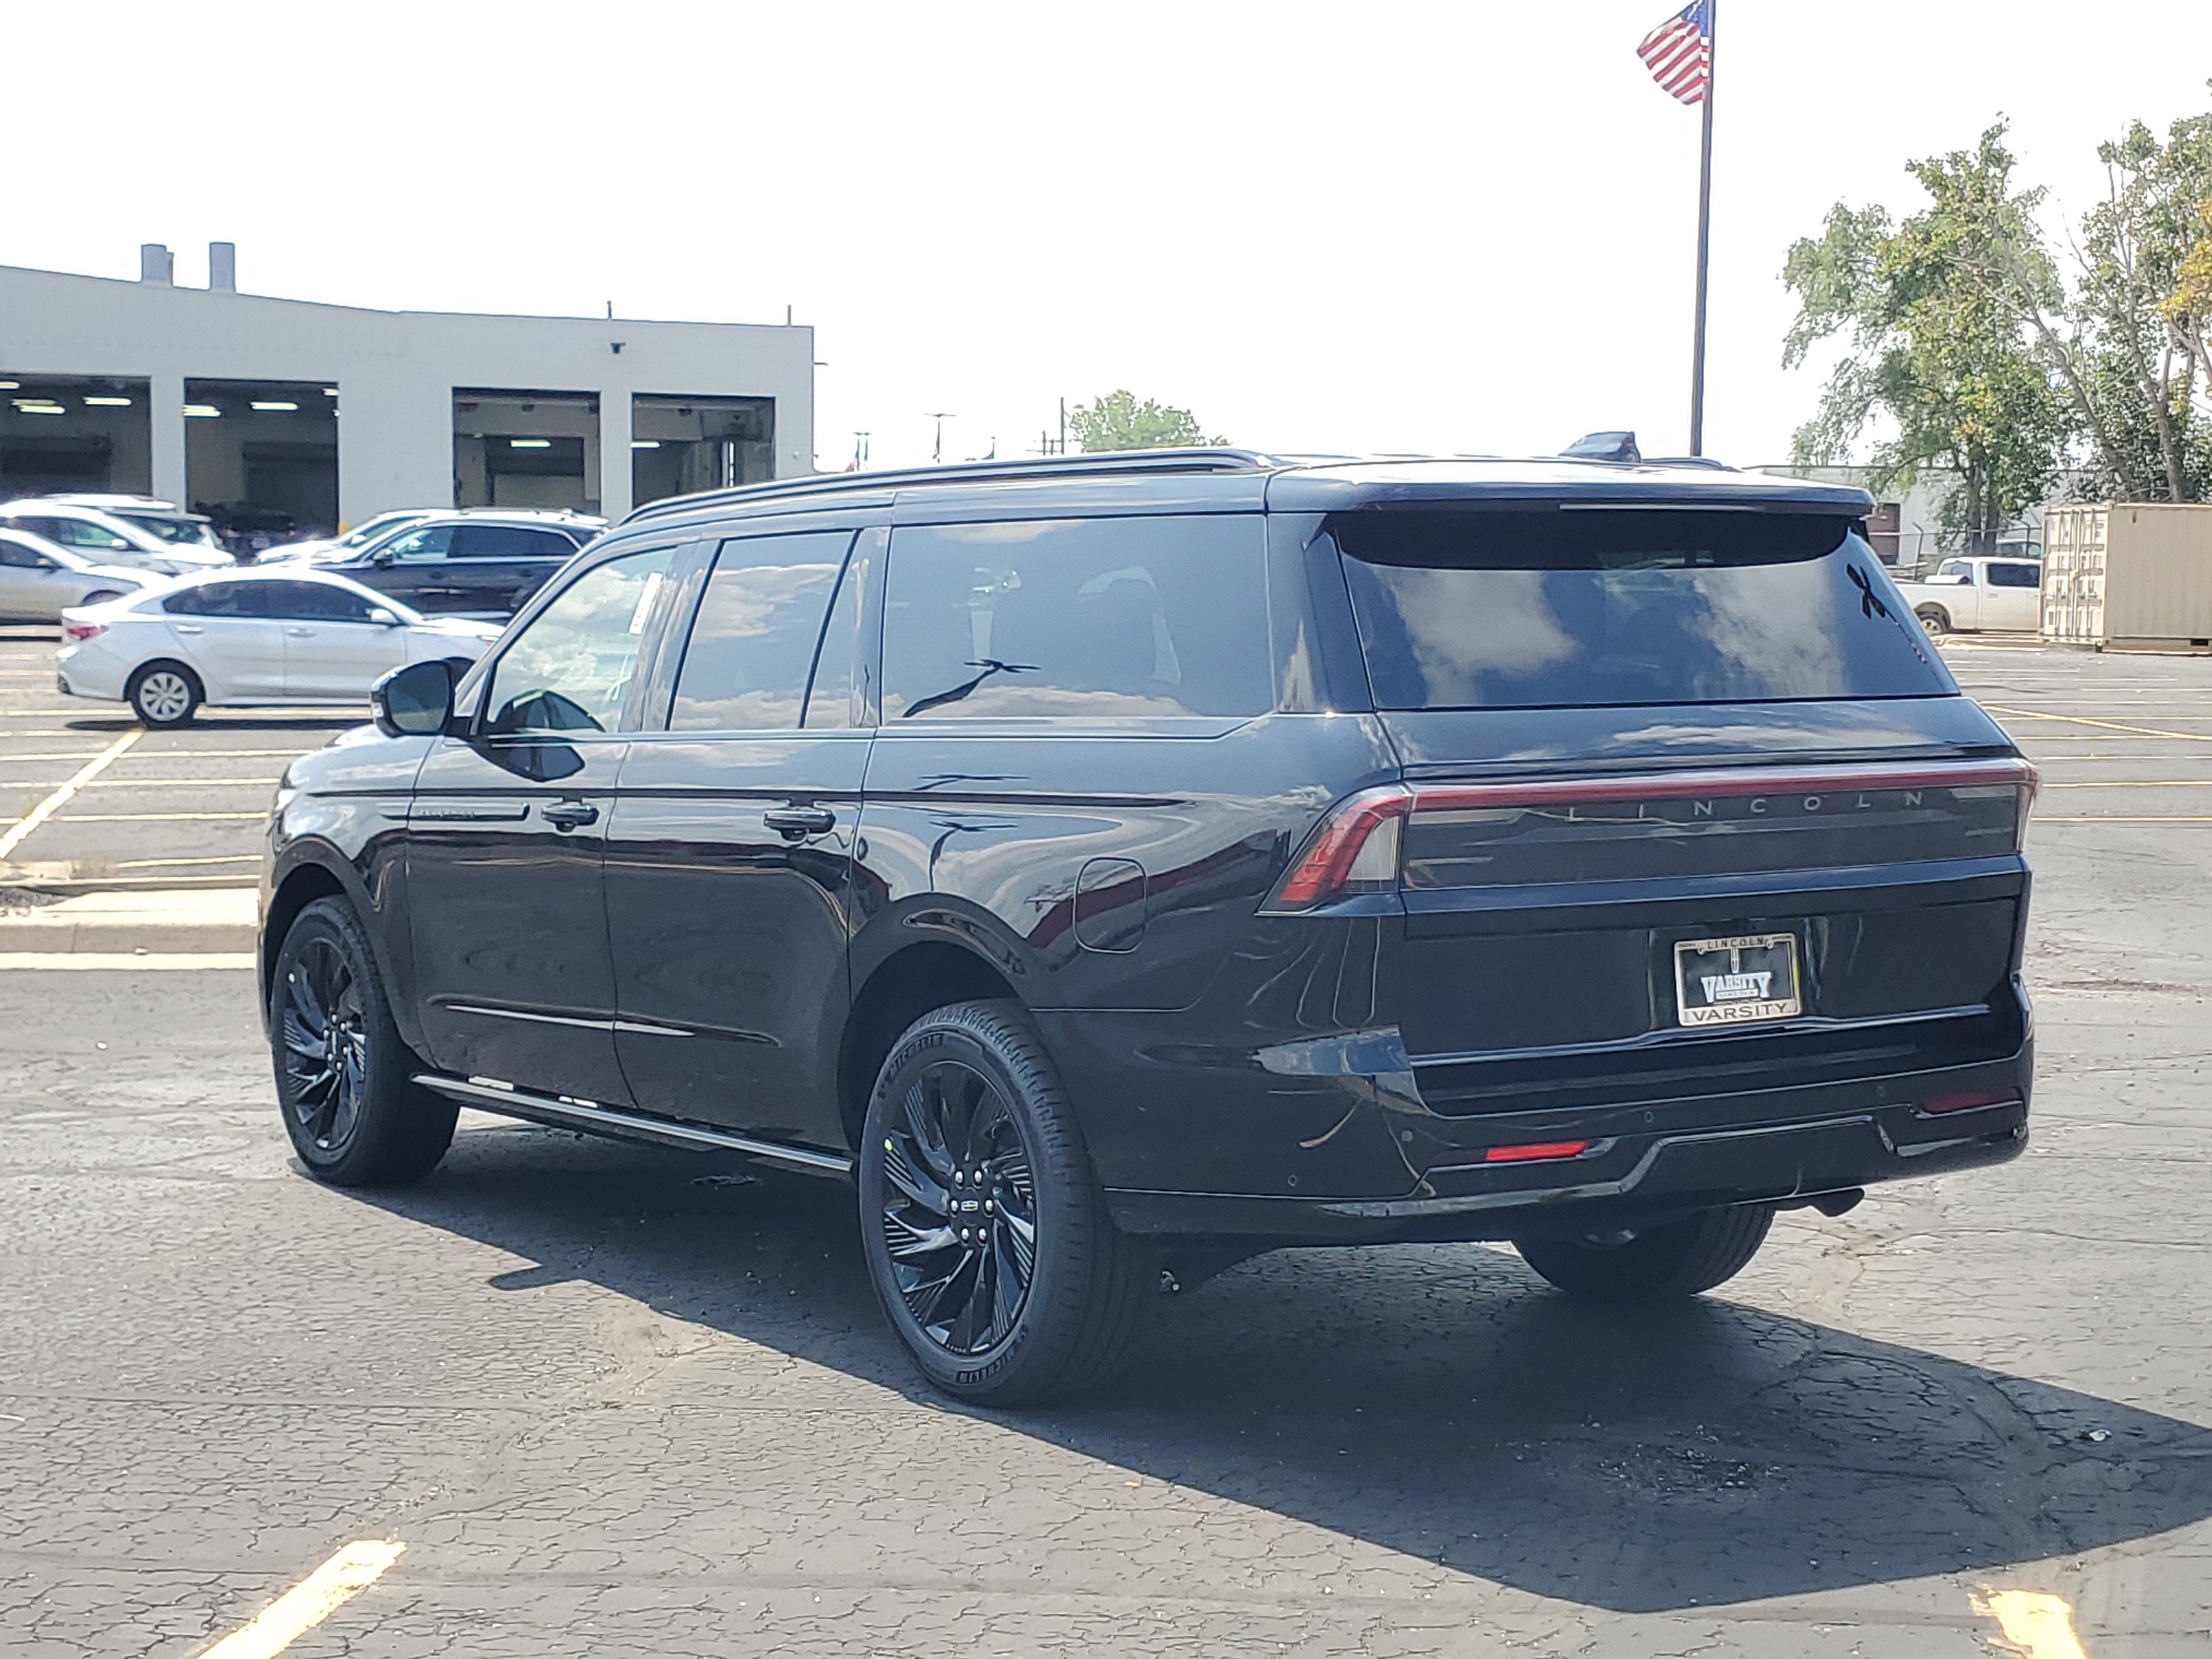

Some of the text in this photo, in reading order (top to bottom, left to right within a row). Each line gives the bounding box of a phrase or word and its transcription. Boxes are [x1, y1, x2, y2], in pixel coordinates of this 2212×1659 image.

[1566, 791, 1923, 822] LINCOLN
[1707, 936, 1764, 950] LINCOLN
[1701, 972, 1771, 1003] VARSITY
[1692, 1002, 1788, 1022] VARSITY
